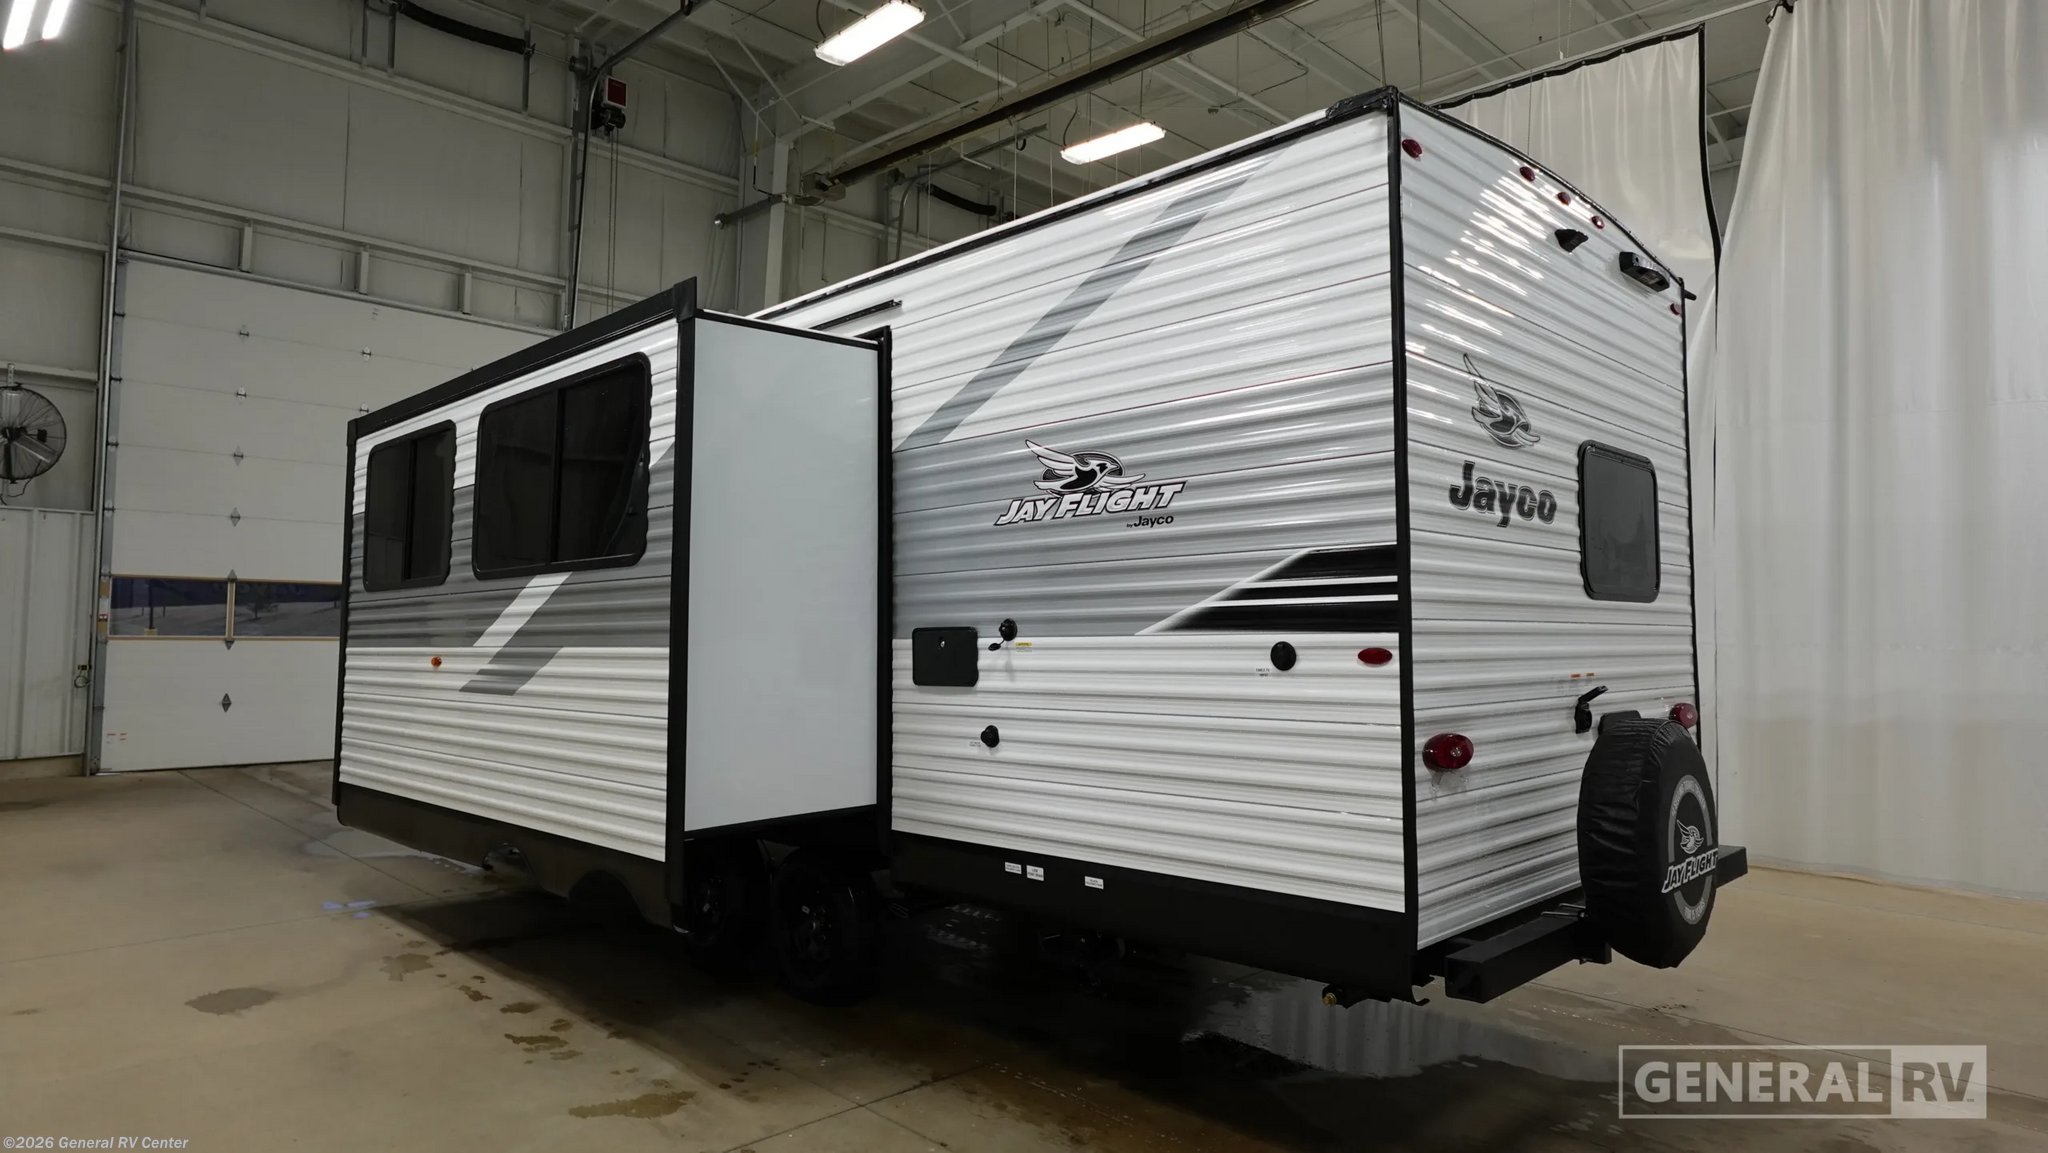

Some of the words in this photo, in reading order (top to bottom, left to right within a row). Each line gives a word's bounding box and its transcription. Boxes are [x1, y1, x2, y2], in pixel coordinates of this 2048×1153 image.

[994, 497, 1057, 526] JAY
[1052, 481, 1186, 519] FLIGHT
[1449, 460, 1557, 528] Jayco
[1133, 515, 1174, 528] Jayco
[1661, 862, 1686, 893] JAY
[1683, 848, 1718, 883] FLIGHT
